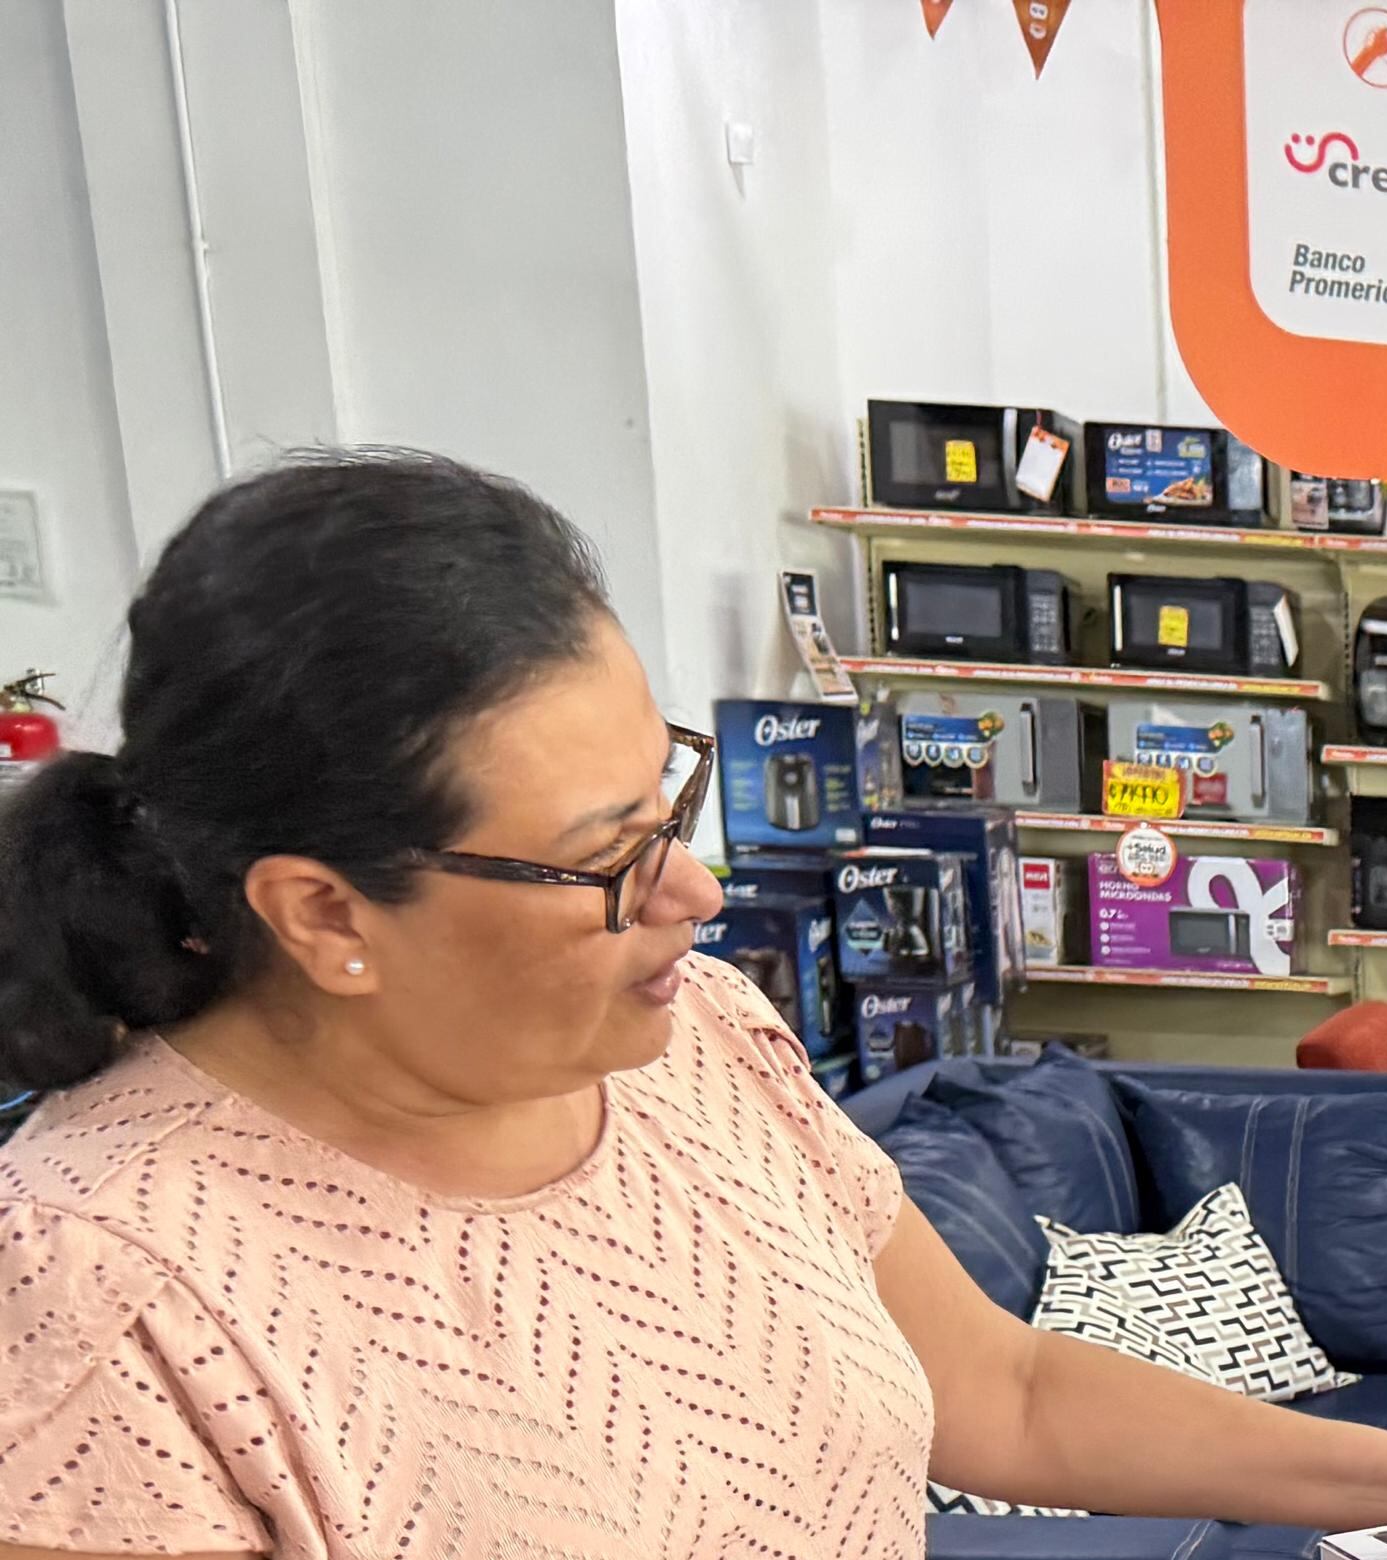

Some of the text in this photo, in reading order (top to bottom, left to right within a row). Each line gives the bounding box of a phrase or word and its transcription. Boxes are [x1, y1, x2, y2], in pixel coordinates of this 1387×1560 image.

[1293, 243, 1366, 273] Banco
[754, 714, 822, 747] Oster
[838, 864, 898, 895] Oster
[861, 994, 912, 1019] Oster
